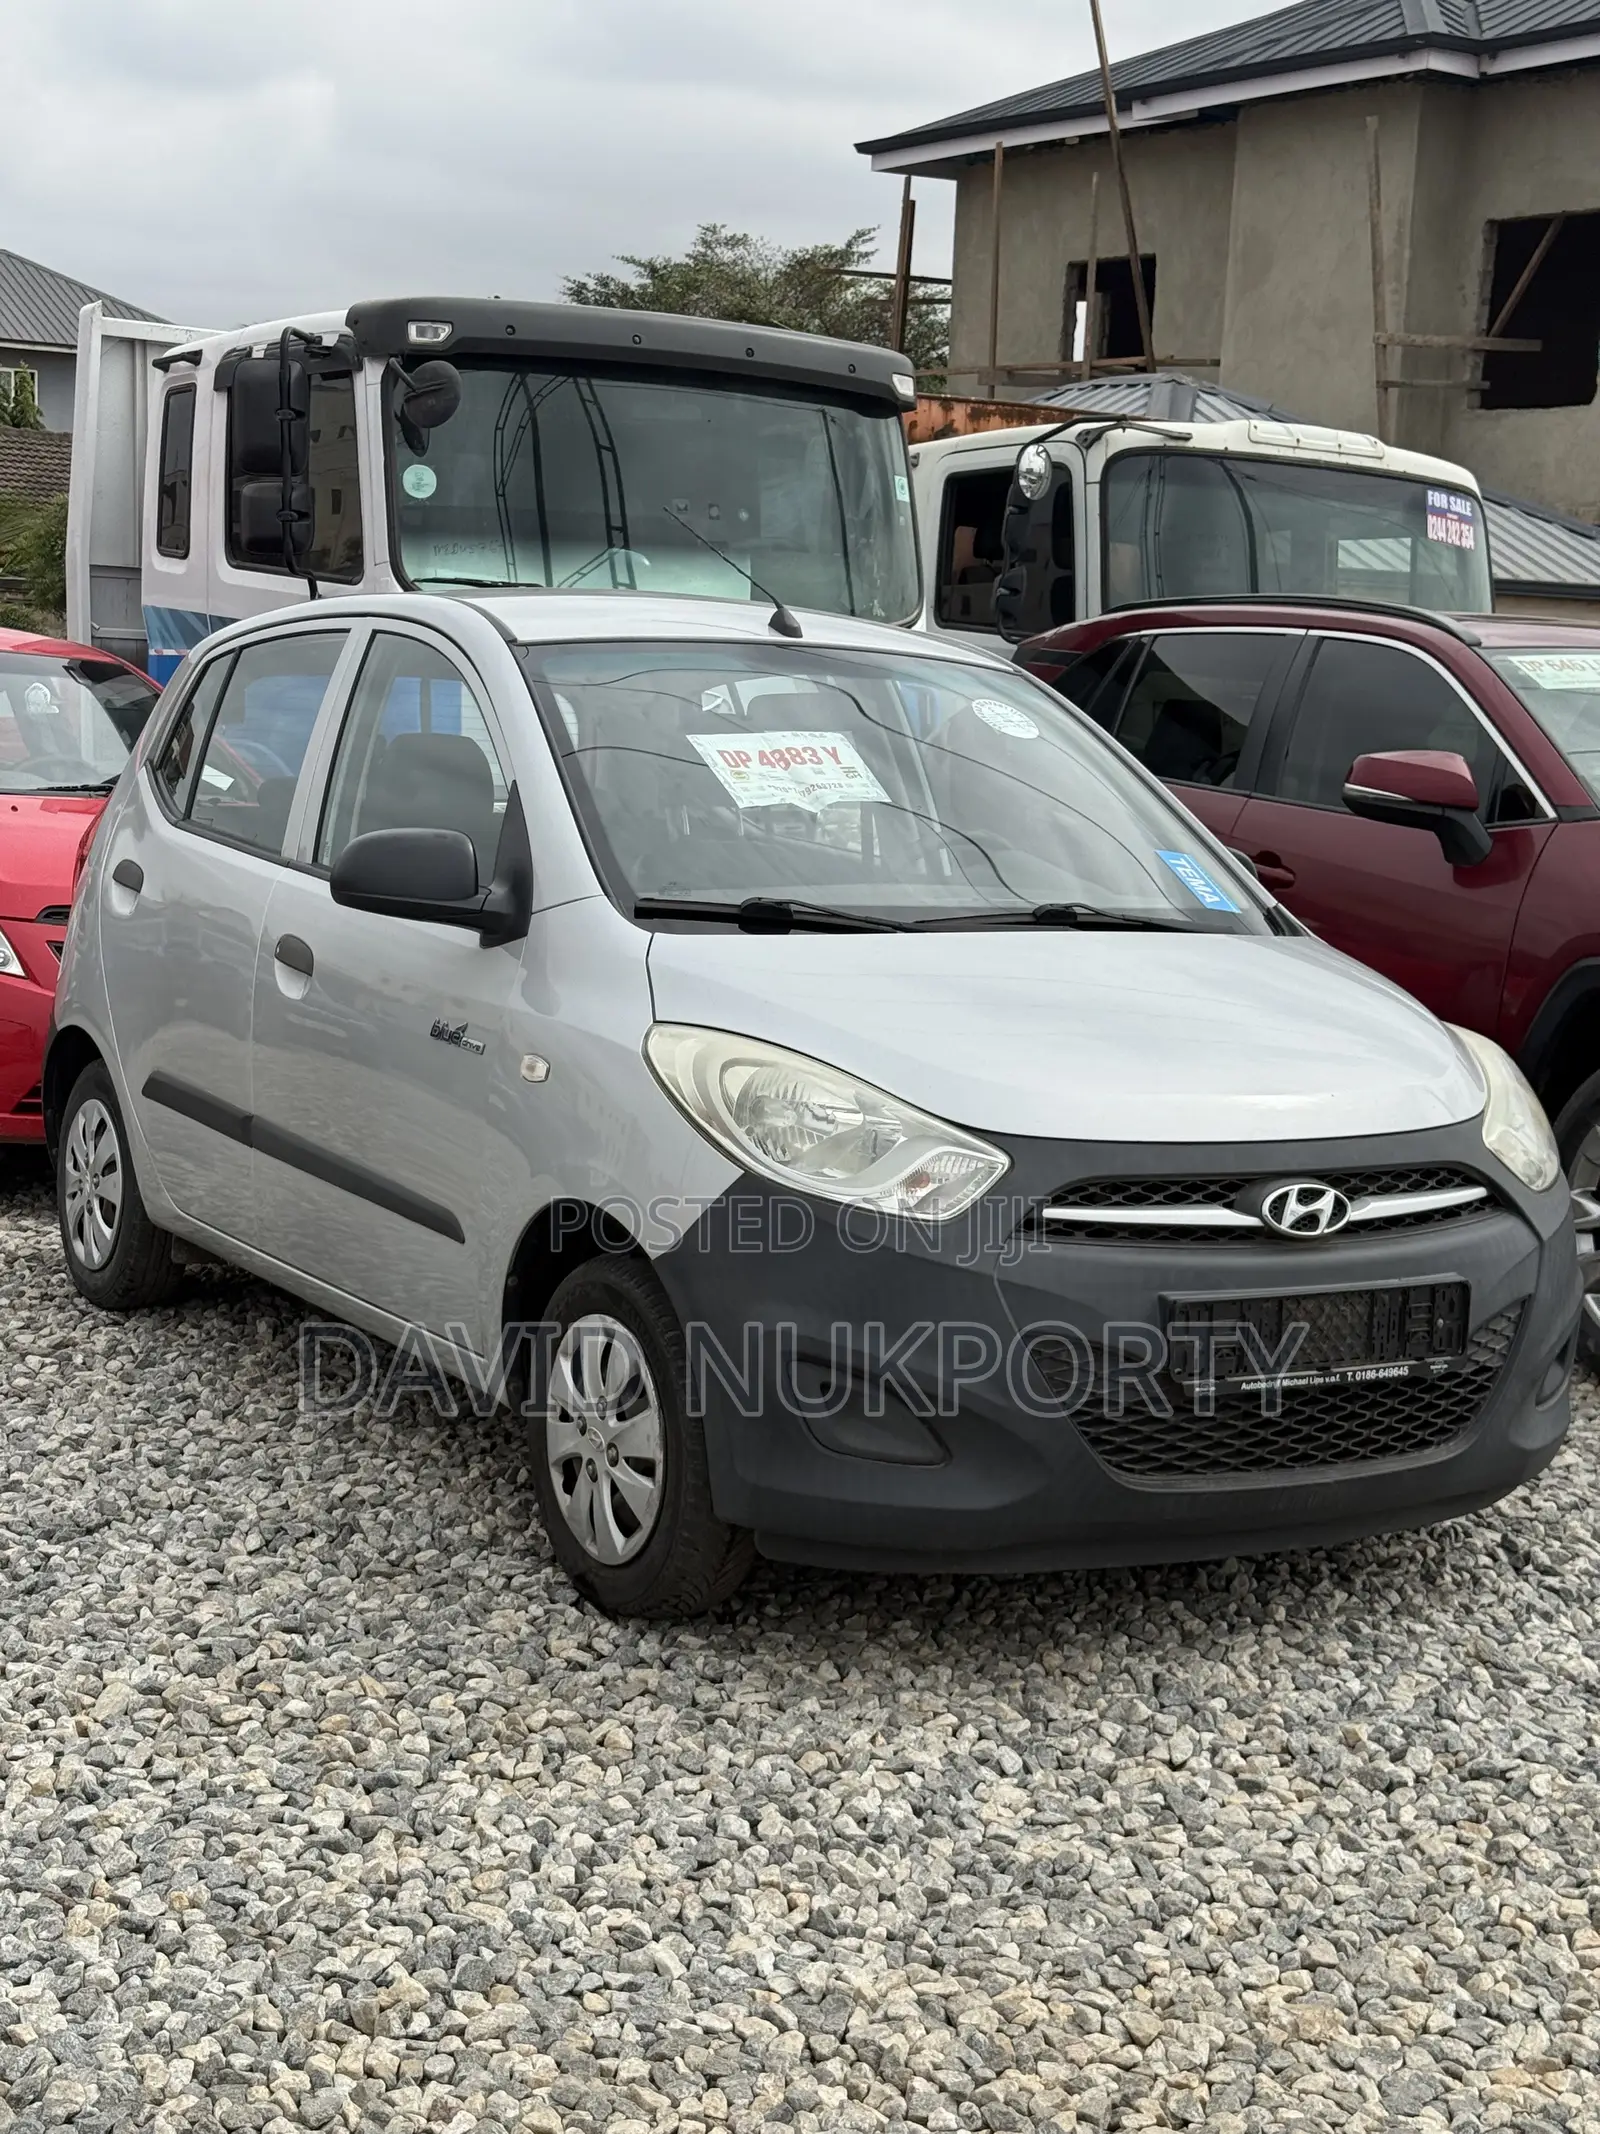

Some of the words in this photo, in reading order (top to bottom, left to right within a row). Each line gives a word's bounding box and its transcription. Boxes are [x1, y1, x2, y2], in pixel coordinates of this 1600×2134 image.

[1427, 490, 1448, 509] FOR
[1449, 496, 1472, 517] SALE
[1427, 514, 1447, 543] 0244
[1446, 518, 1461, 547] 242
[716, 749, 753, 769] DP
[820, 746, 843, 765] Y
[1168, 858, 1221, 903] TEMA
[1282, 1376, 1309, 1387] Michael
[1355, 1365, 1410, 1380] 0186-649645
